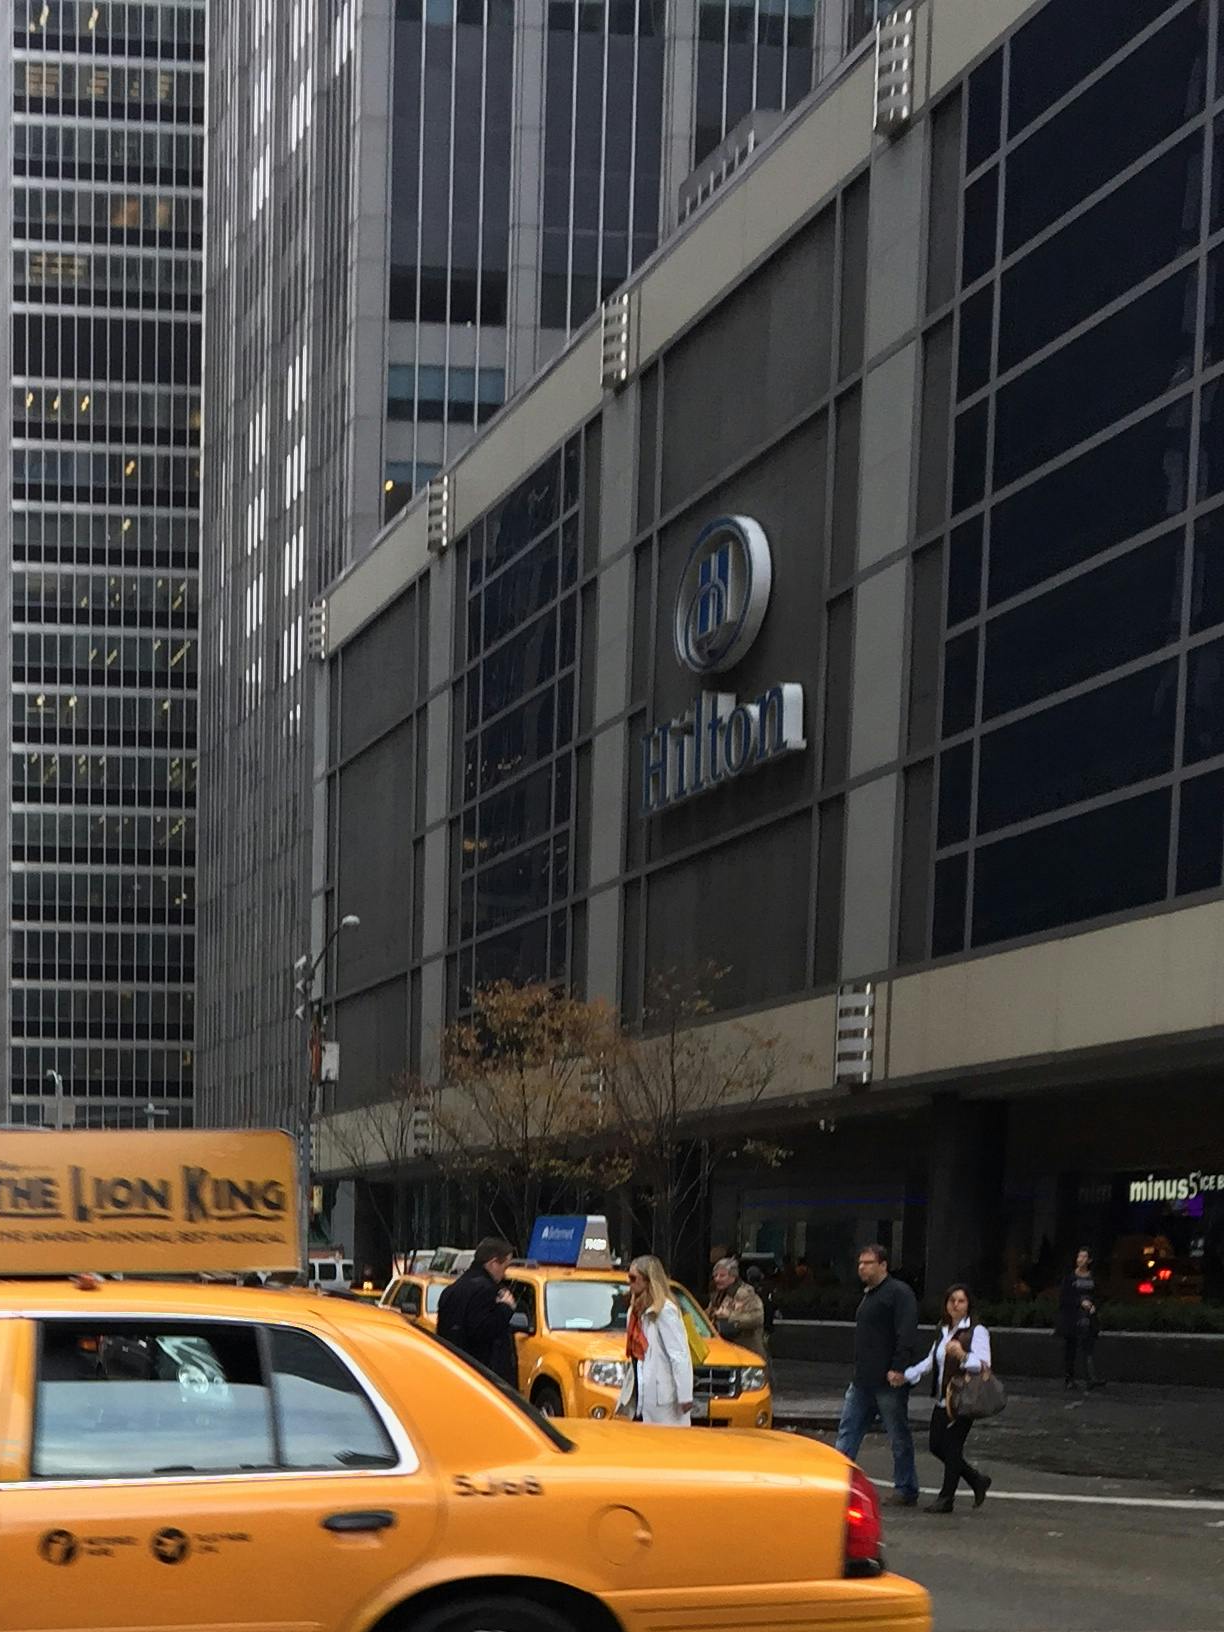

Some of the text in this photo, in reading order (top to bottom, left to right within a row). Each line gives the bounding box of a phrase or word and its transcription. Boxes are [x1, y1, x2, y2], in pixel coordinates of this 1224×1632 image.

[641, 683, 804, 813] Hilton
[67, 1164, 172, 1223] LION
[181, 1164, 287, 1223] KING
